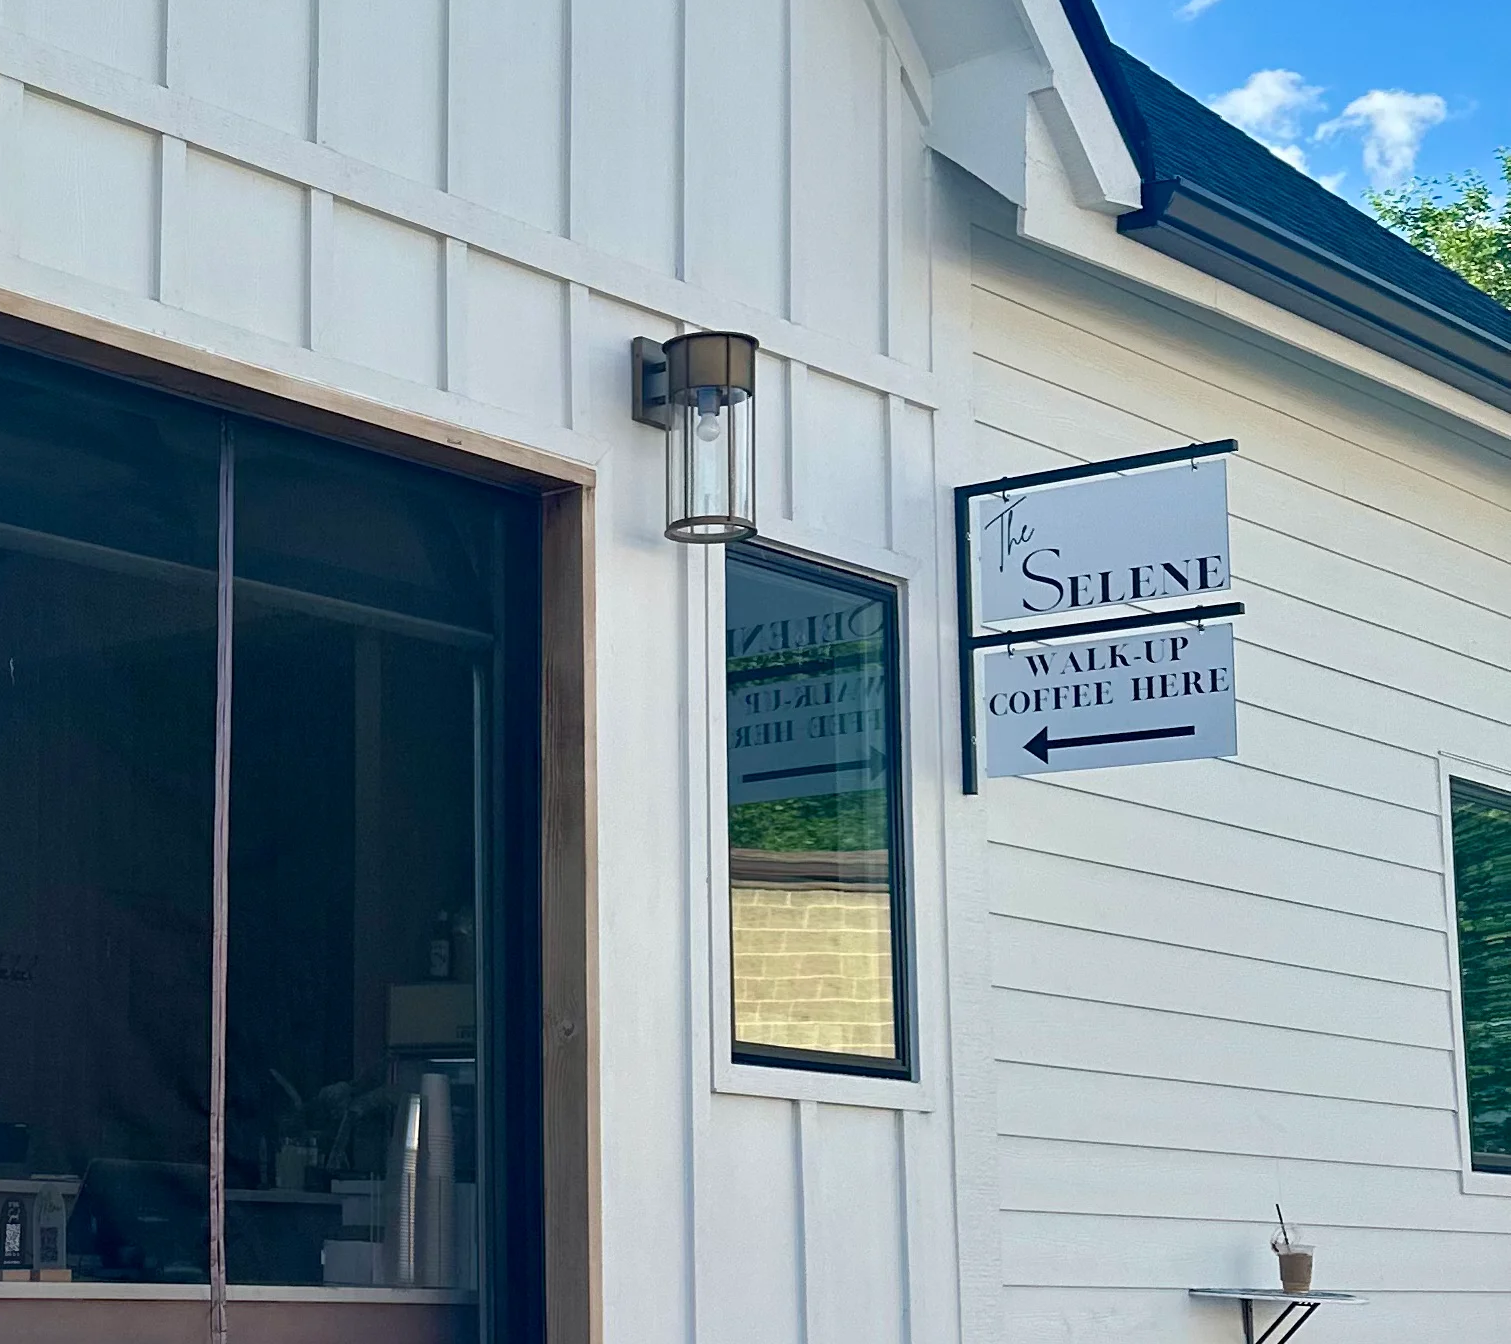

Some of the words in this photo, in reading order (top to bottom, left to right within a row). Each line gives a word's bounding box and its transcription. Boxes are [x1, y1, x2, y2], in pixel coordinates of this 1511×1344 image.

[984, 496, 1035, 573] The
[1021, 548, 1226, 613] SELENE
[1025, 635, 1190, 678] WALK-UP
[988, 680, 1115, 717] COFFEE
[1131, 667, 1231, 702] HERE
